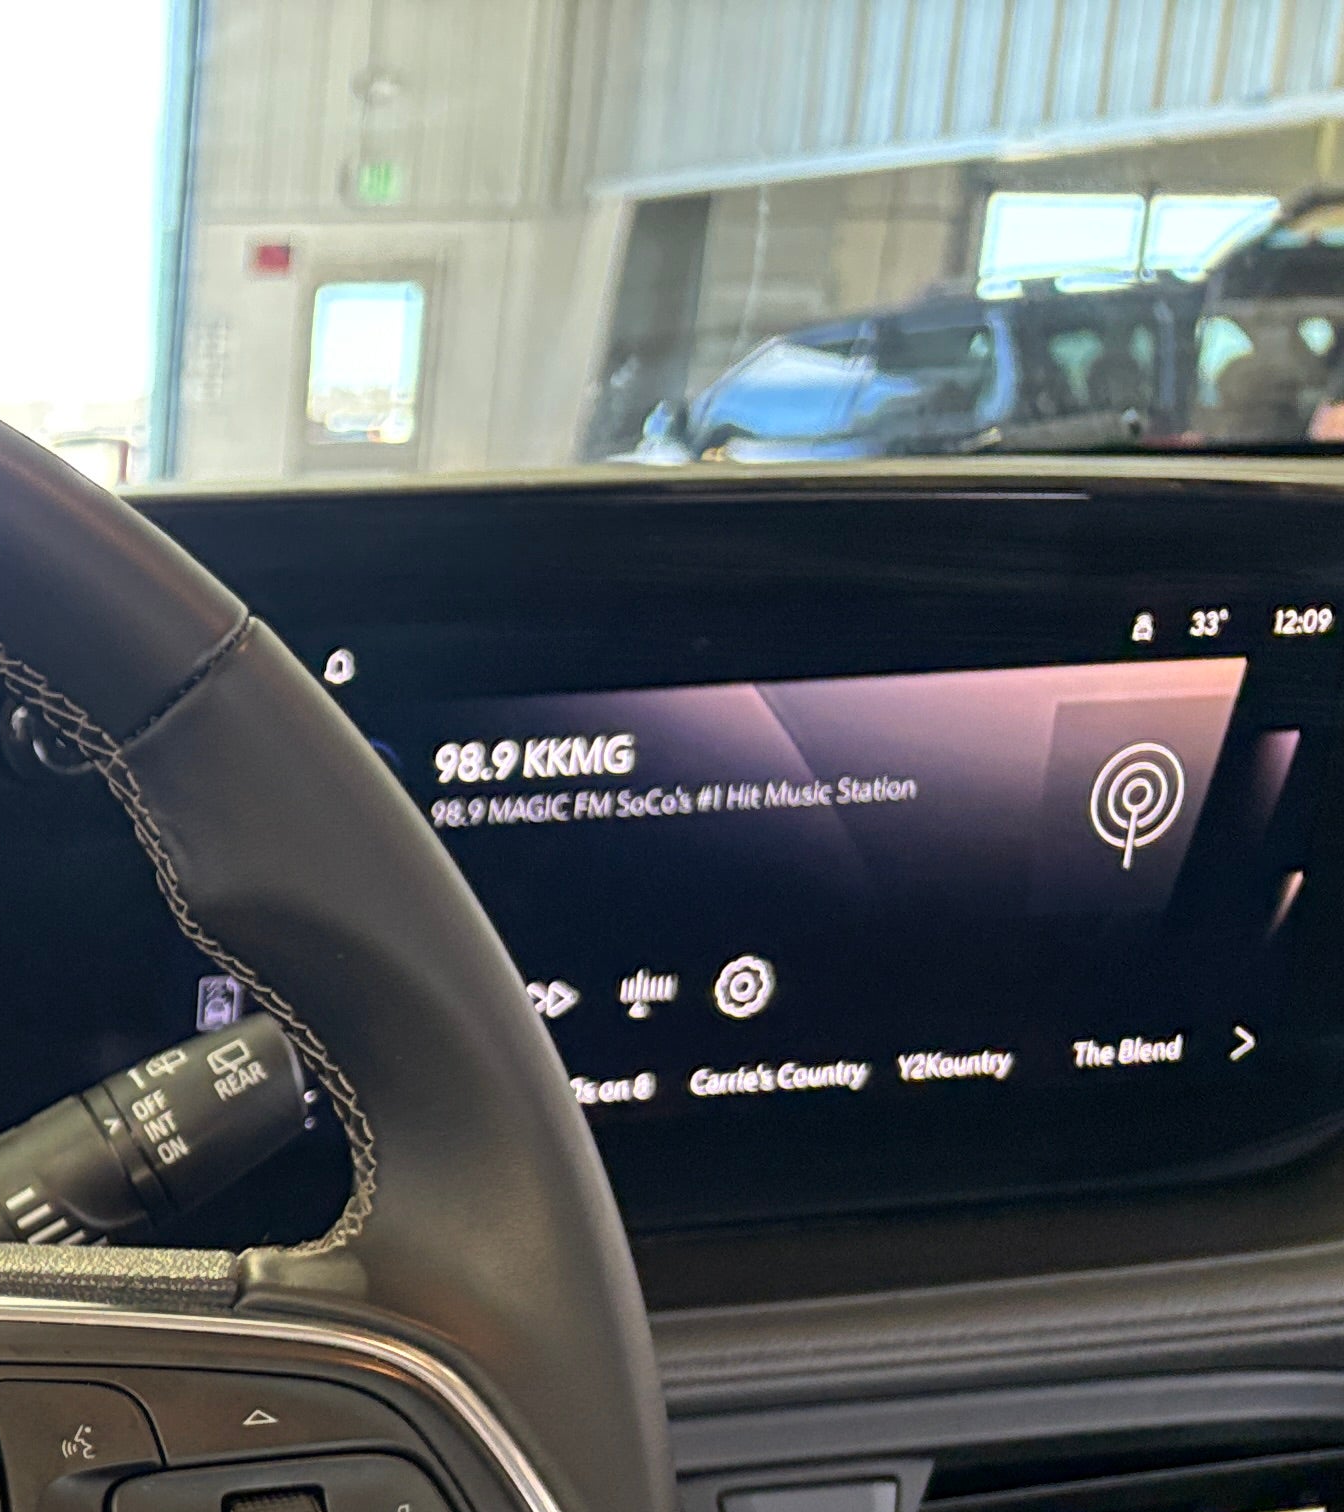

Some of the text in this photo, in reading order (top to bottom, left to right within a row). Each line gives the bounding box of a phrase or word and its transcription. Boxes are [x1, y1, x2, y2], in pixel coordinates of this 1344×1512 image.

[1272, 607, 1334, 636] 12:09
[434, 734, 636, 783] 98.9 KKMG
[430, 800, 484, 828] 98.9
[487, 796, 570, 824] MAGIC
[573, 793, 611, 820] FM
[615, 787, 693, 816] SoCo's
[725, 782, 761, 809] Hit
[764, 777, 832, 807] Music
[836, 774, 917, 803] Station
[897, 1048, 1013, 1082] Y2Kountry
[1073, 1033, 1183, 1068] The Blend
[215, 1062, 269, 1101] REAR
[599, 1080, 634, 1103] on
[690, 1059, 868, 1097] Carrie's Country
[132, 1091, 167, 1122] OFF
[143, 1113, 179, 1144] INT
[157, 1137, 190, 1165] ON
